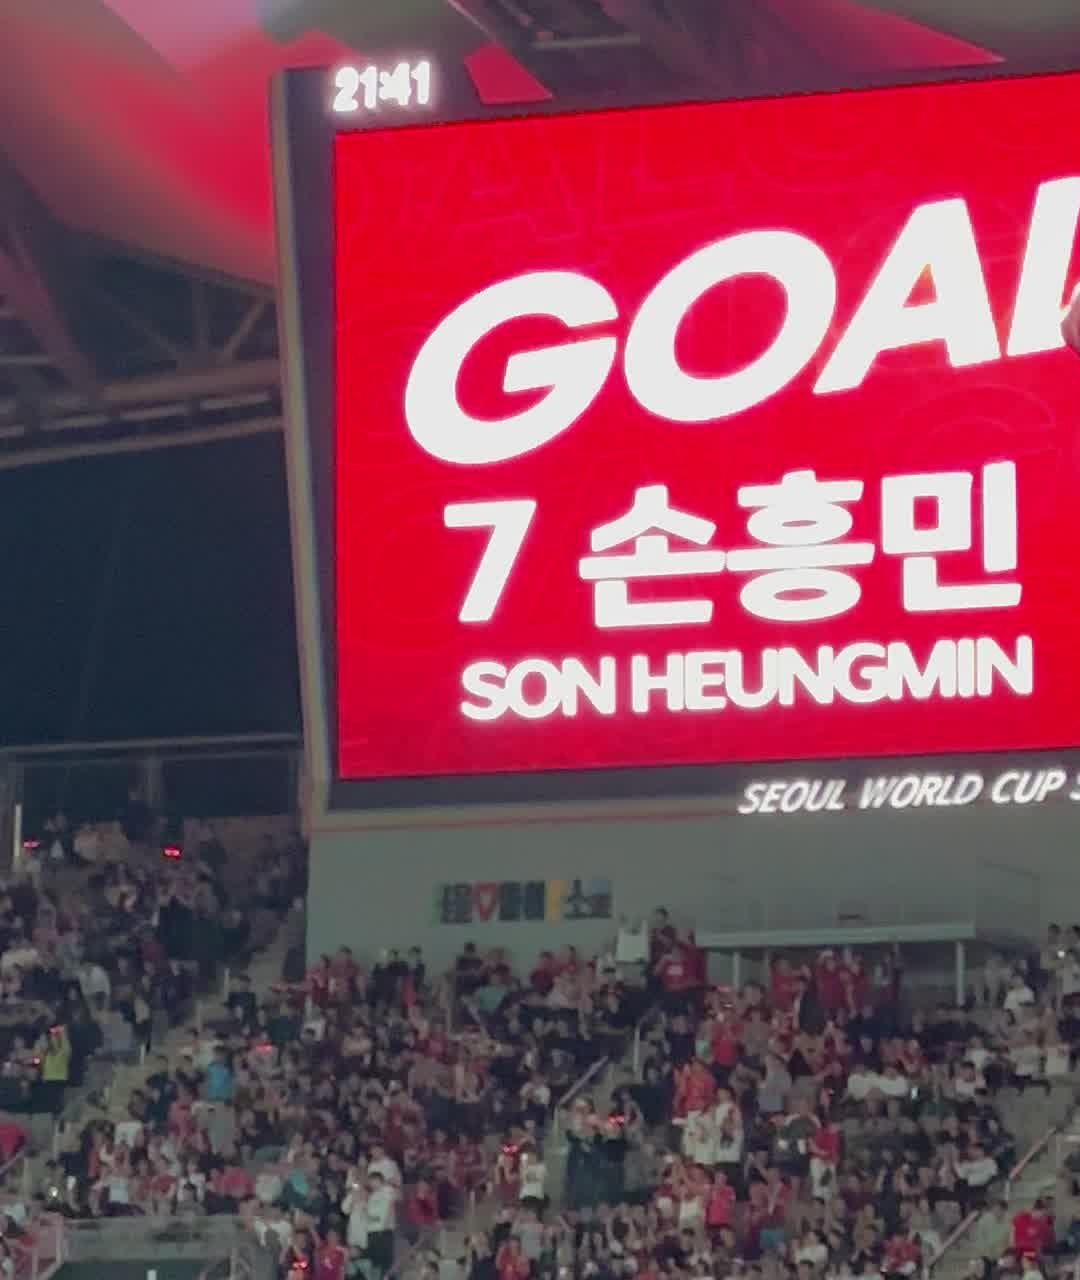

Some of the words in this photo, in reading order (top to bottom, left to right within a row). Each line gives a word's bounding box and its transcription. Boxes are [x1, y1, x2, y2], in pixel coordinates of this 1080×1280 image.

[332, 61, 431, 112] 21:41
[443, 500, 537, 623] 7
[578, 461, 1023, 629] 손흥민
[460, 656, 617, 722] SON
[630, 636, 1033, 714] HEUNGMIN
[737, 778, 846, 815] SEOUL
[858, 773, 984, 810] WORLD
[990, 768, 1067, 805] CUP
